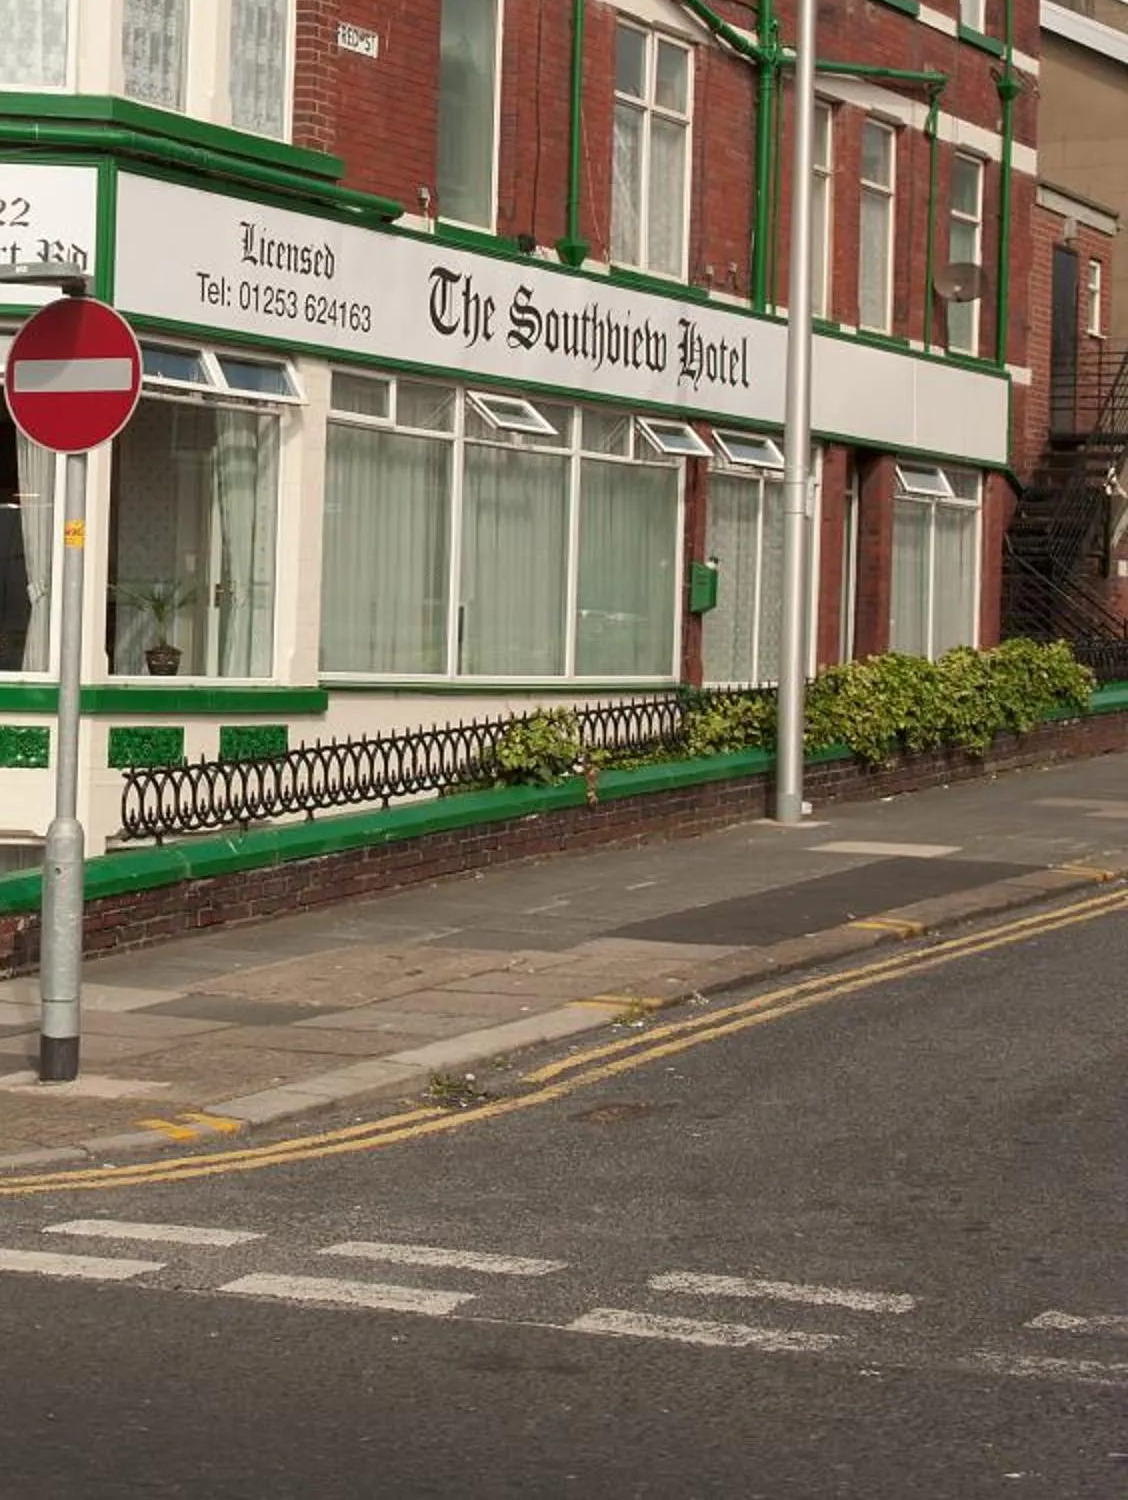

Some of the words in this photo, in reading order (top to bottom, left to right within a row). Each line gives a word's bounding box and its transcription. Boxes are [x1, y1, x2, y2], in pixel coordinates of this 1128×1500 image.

[36, 238, 88, 272] Rd
[239, 221, 336, 280] Licensed
[196, 271, 232, 308] Tel:
[238, 281, 298, 320] 01253
[305, 293, 372, 333] 624163
[428, 266, 497, 349] The
[506, 284, 668, 374] Southview
[678, 317, 750, 390] Hotel
